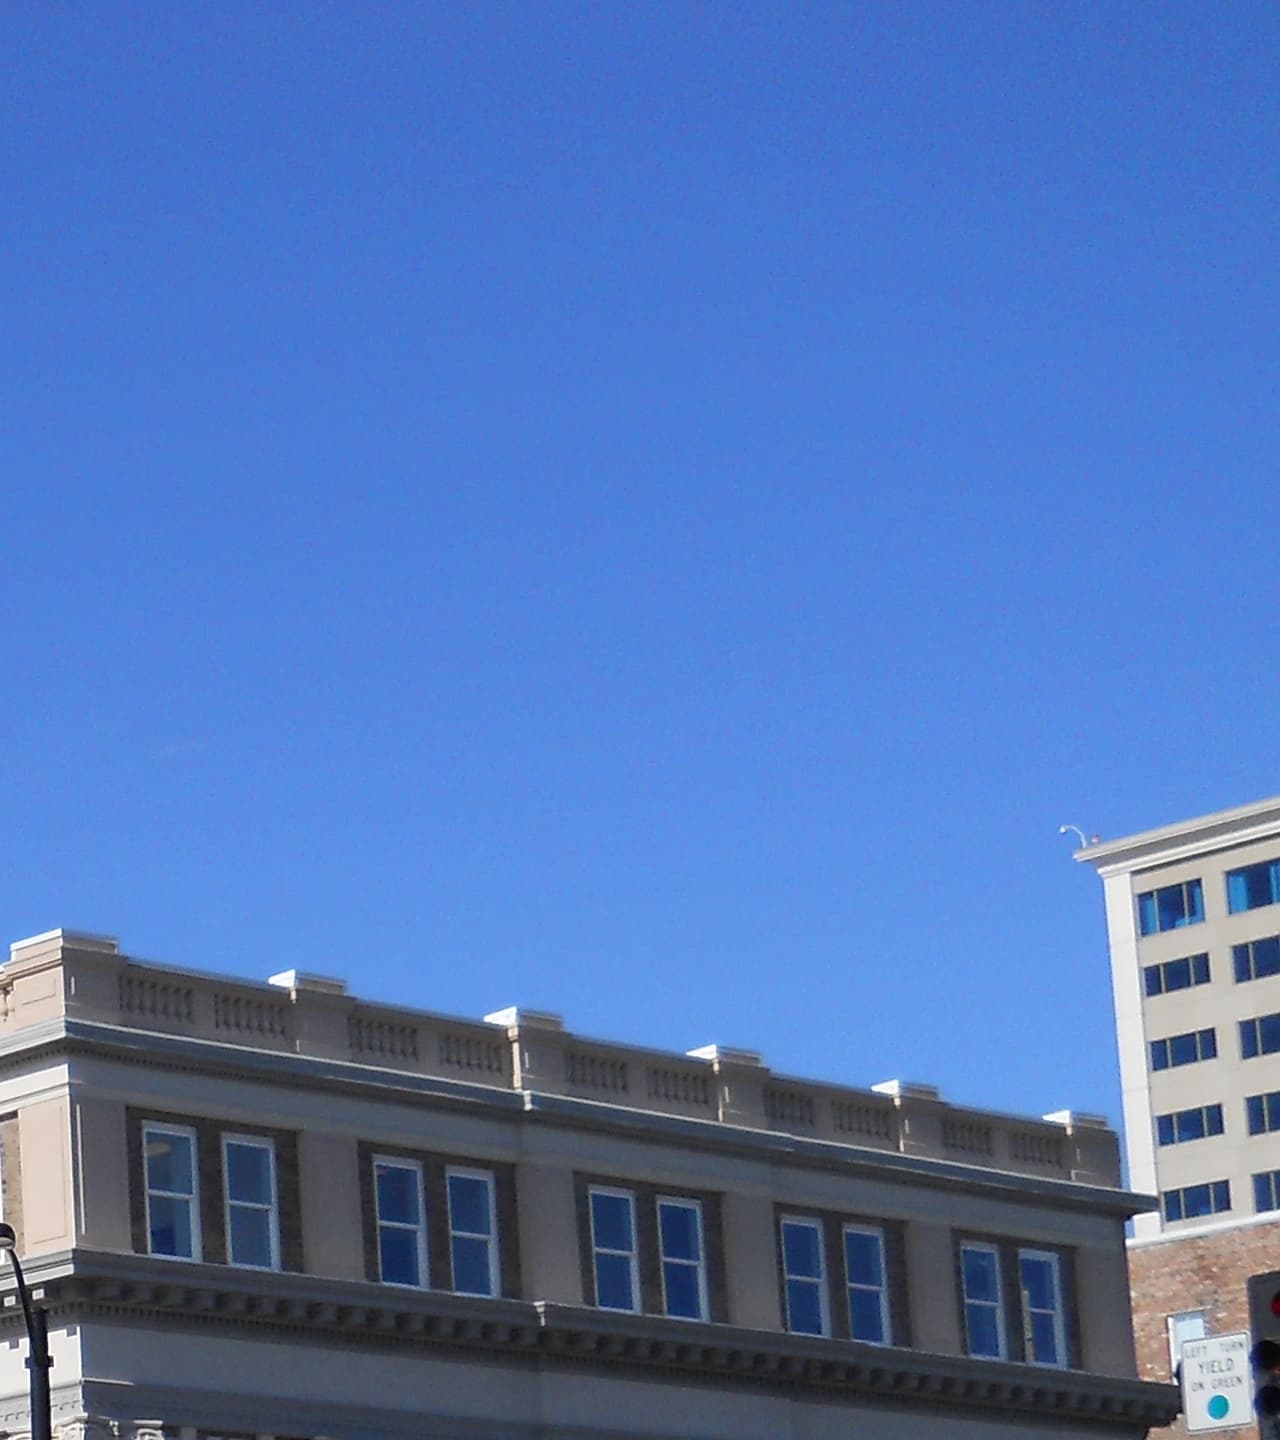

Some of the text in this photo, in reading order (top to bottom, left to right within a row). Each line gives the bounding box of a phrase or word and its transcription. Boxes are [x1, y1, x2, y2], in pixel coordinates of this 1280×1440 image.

[1184, 1340, 1244, 1359] LEFT TURN
[1198, 1357, 1234, 1375] YIELD
[1191, 1375, 1243, 1392] ON GREEN
